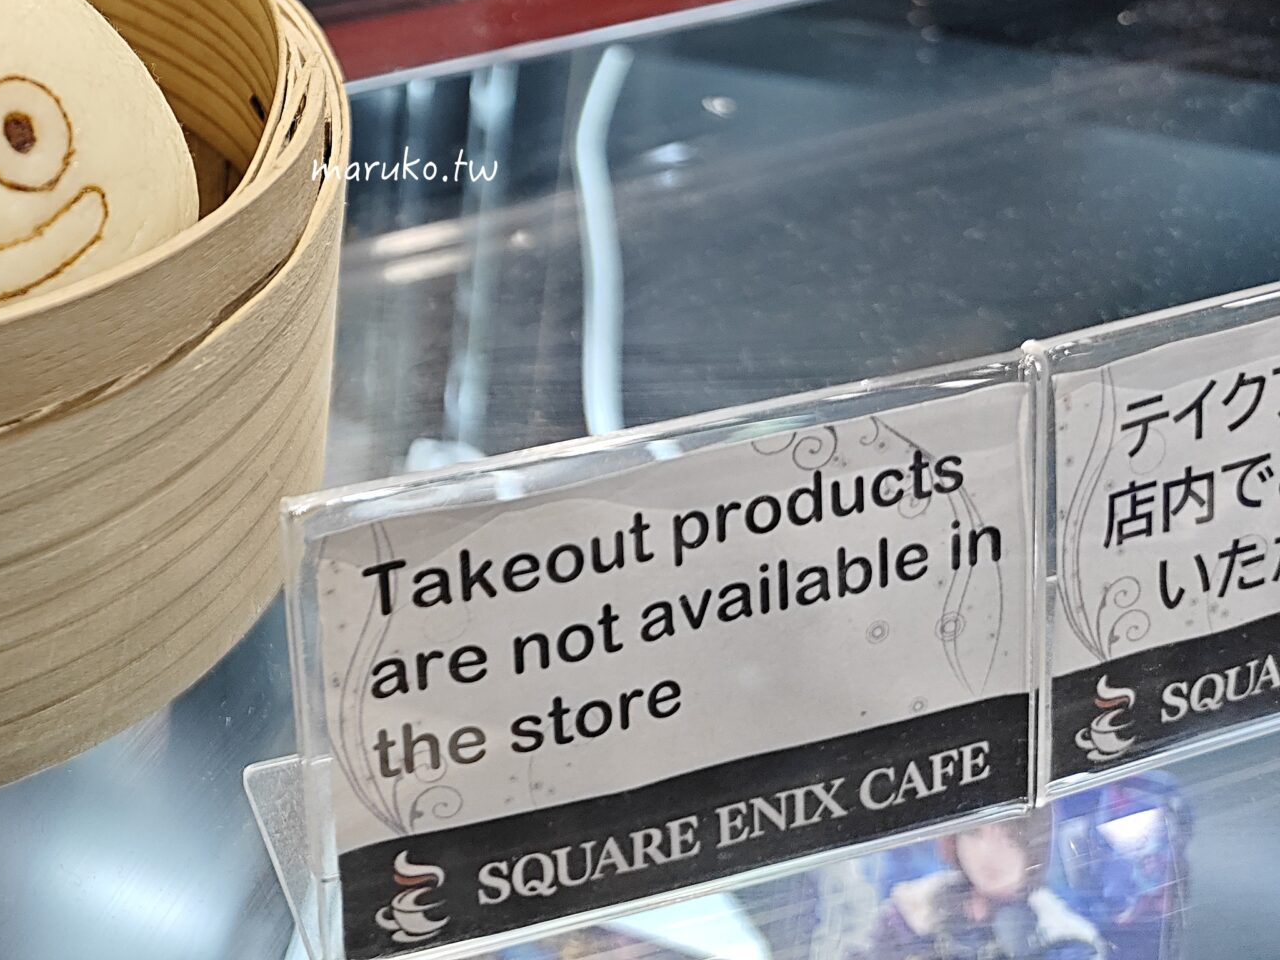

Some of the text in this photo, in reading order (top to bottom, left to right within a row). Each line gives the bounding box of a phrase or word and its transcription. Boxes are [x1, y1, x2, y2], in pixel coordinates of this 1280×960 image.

[1120, 368, 1280, 458] テイク
[362, 450, 964, 616] Takeout products
[1103, 452, 1280, 549] 店内で
[371, 519, 1001, 699] are not available in
[1159, 537, 1280, 610] いた
[373, 679, 681, 778] the store
[478, 740, 991, 906] SQUARE ENIX CAFE
